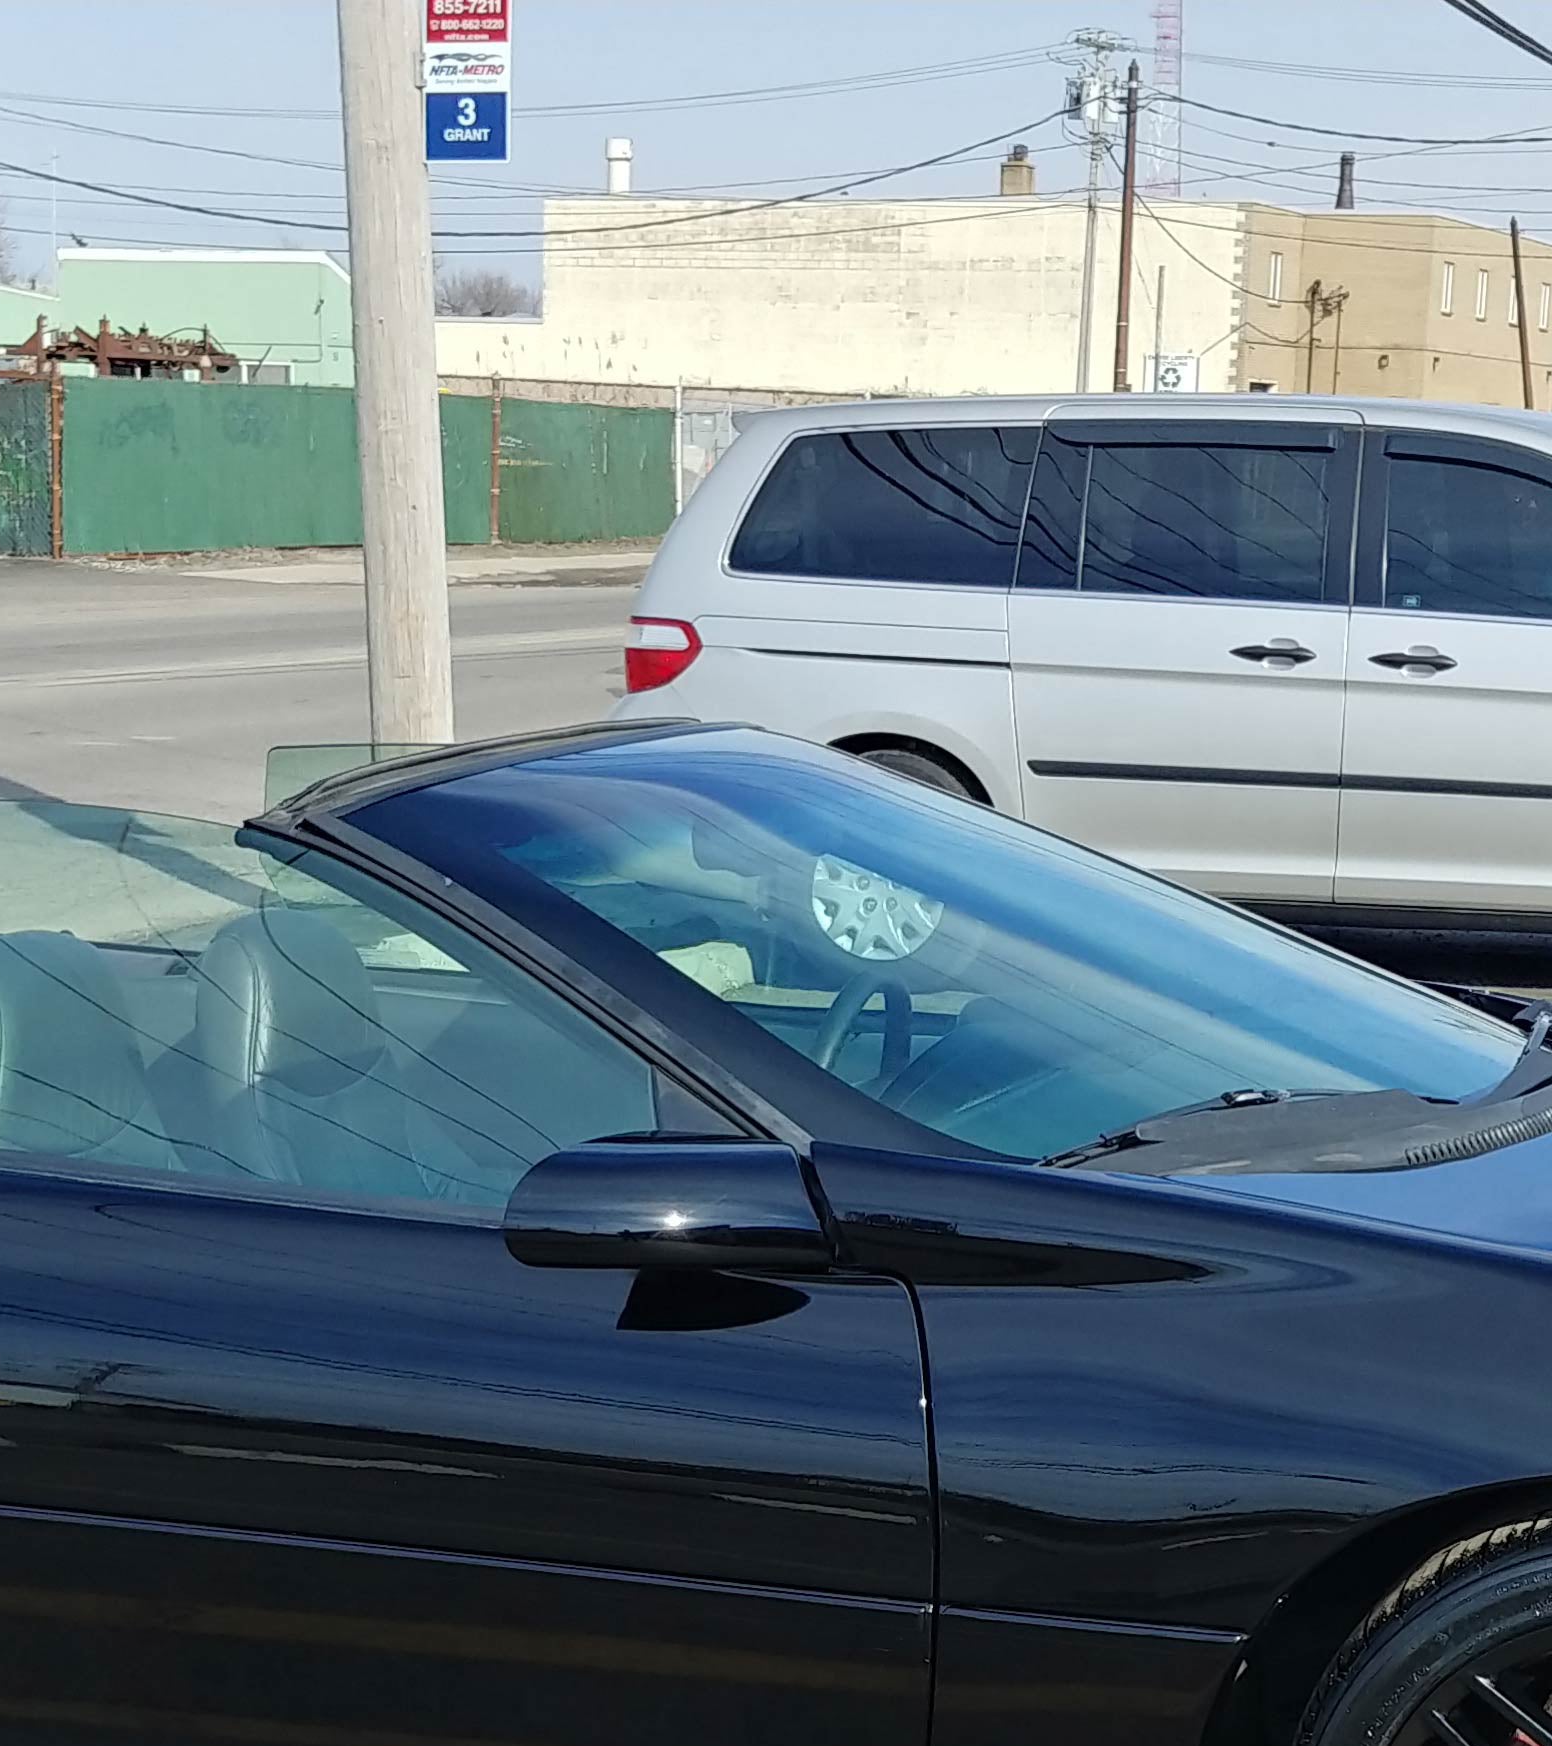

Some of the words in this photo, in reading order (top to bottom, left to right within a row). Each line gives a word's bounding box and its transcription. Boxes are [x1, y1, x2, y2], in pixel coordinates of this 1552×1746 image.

[432, 0, 502, 15] 855-7211
[429, 64, 505, 76] NFTA-METRO
[457, 97, 477, 127] 3
[443, 128, 491, 142] GRANT
